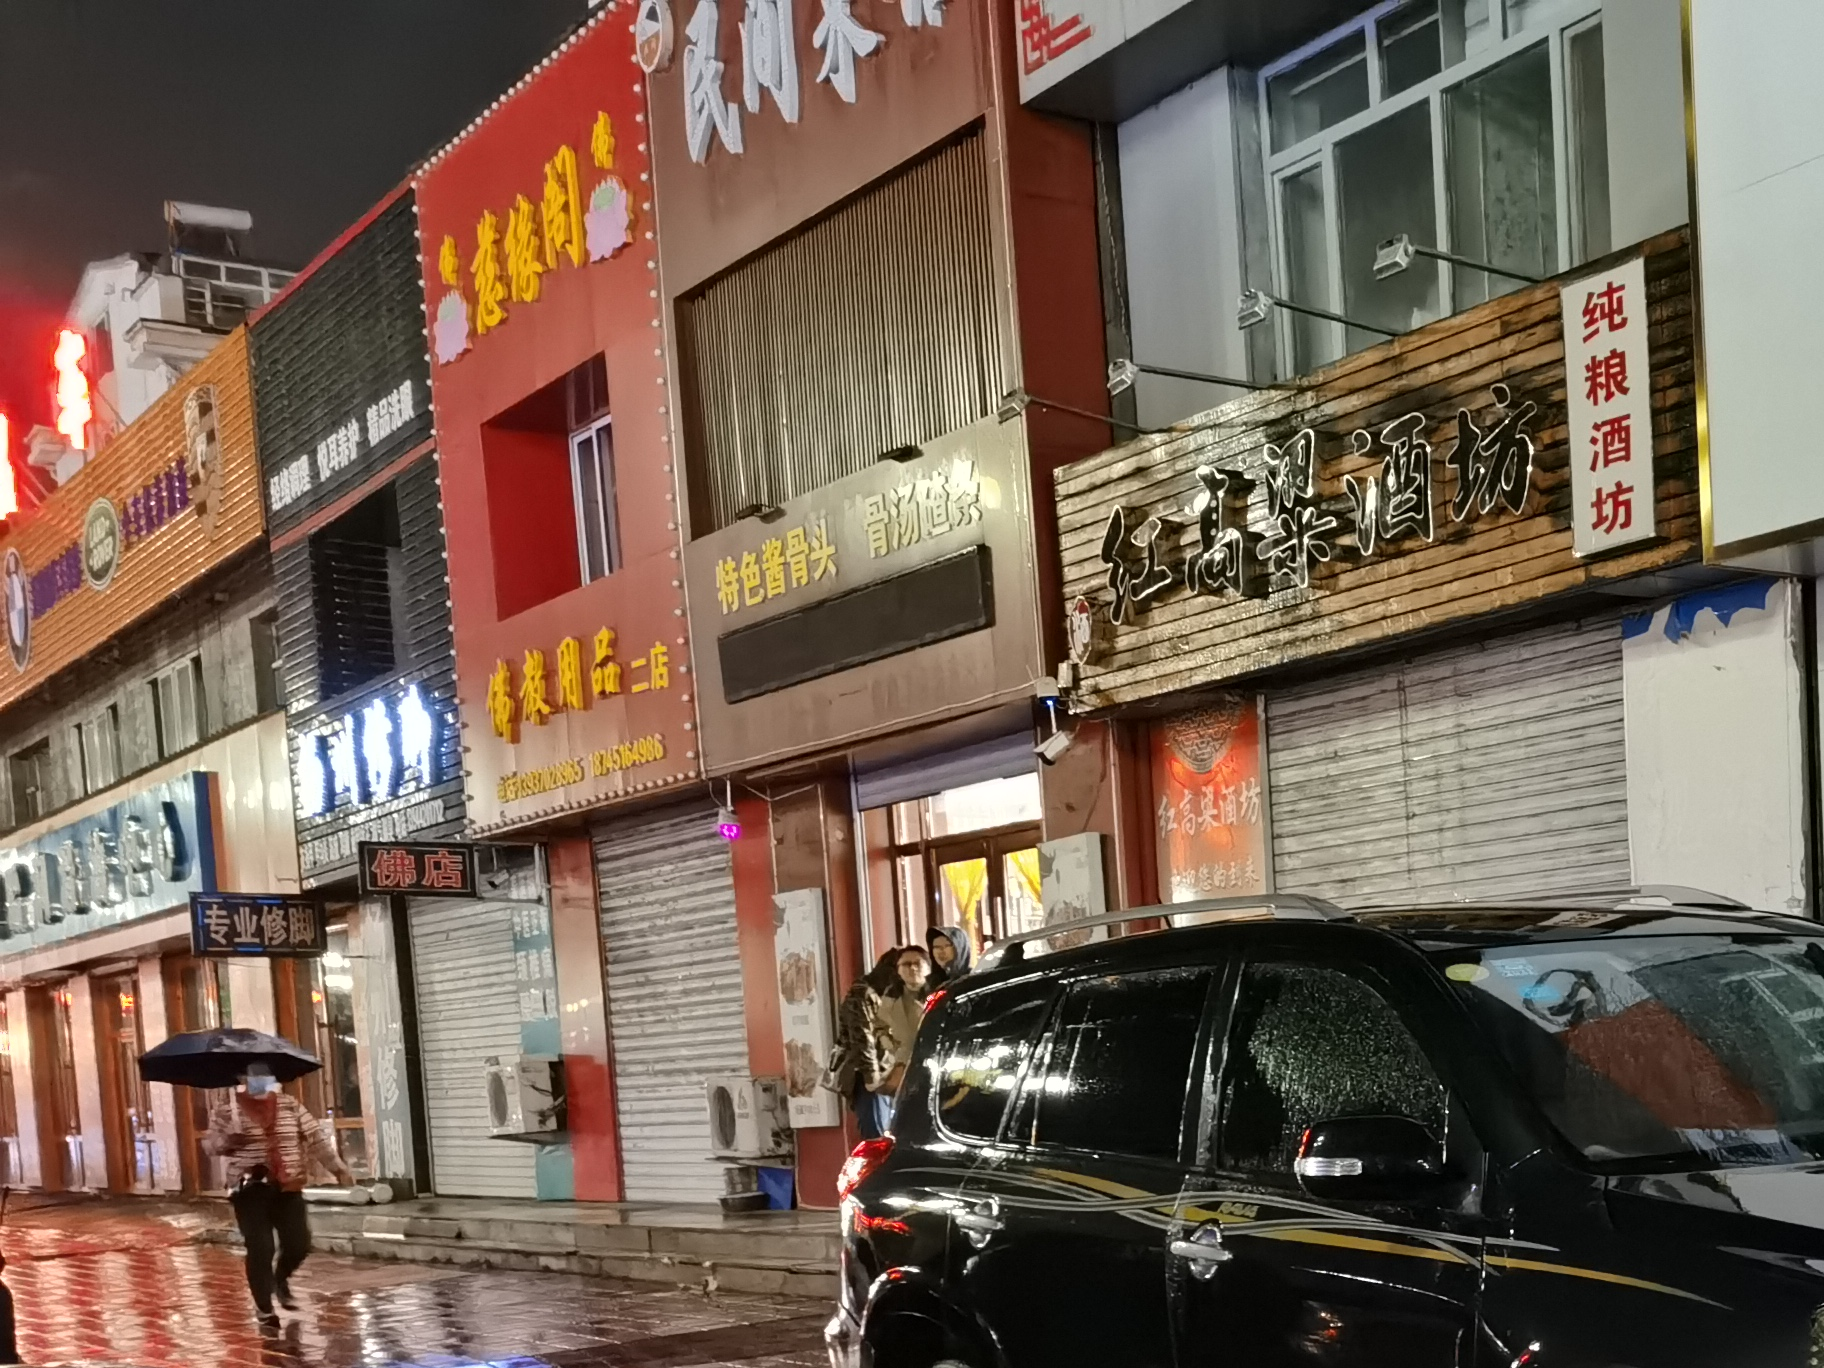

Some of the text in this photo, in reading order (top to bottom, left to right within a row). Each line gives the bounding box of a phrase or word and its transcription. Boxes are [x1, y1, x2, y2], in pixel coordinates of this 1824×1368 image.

[1581, 281, 1635, 536] 纯粮酒坊
[1100, 383, 1540, 626] 红高粱酒坊
[715, 517, 838, 615] 特色酱骨头
[631, 641, 669, 693] 二店
[371, 848, 463, 888] 佛店
[203, 904, 317, 946] 专业修脚
